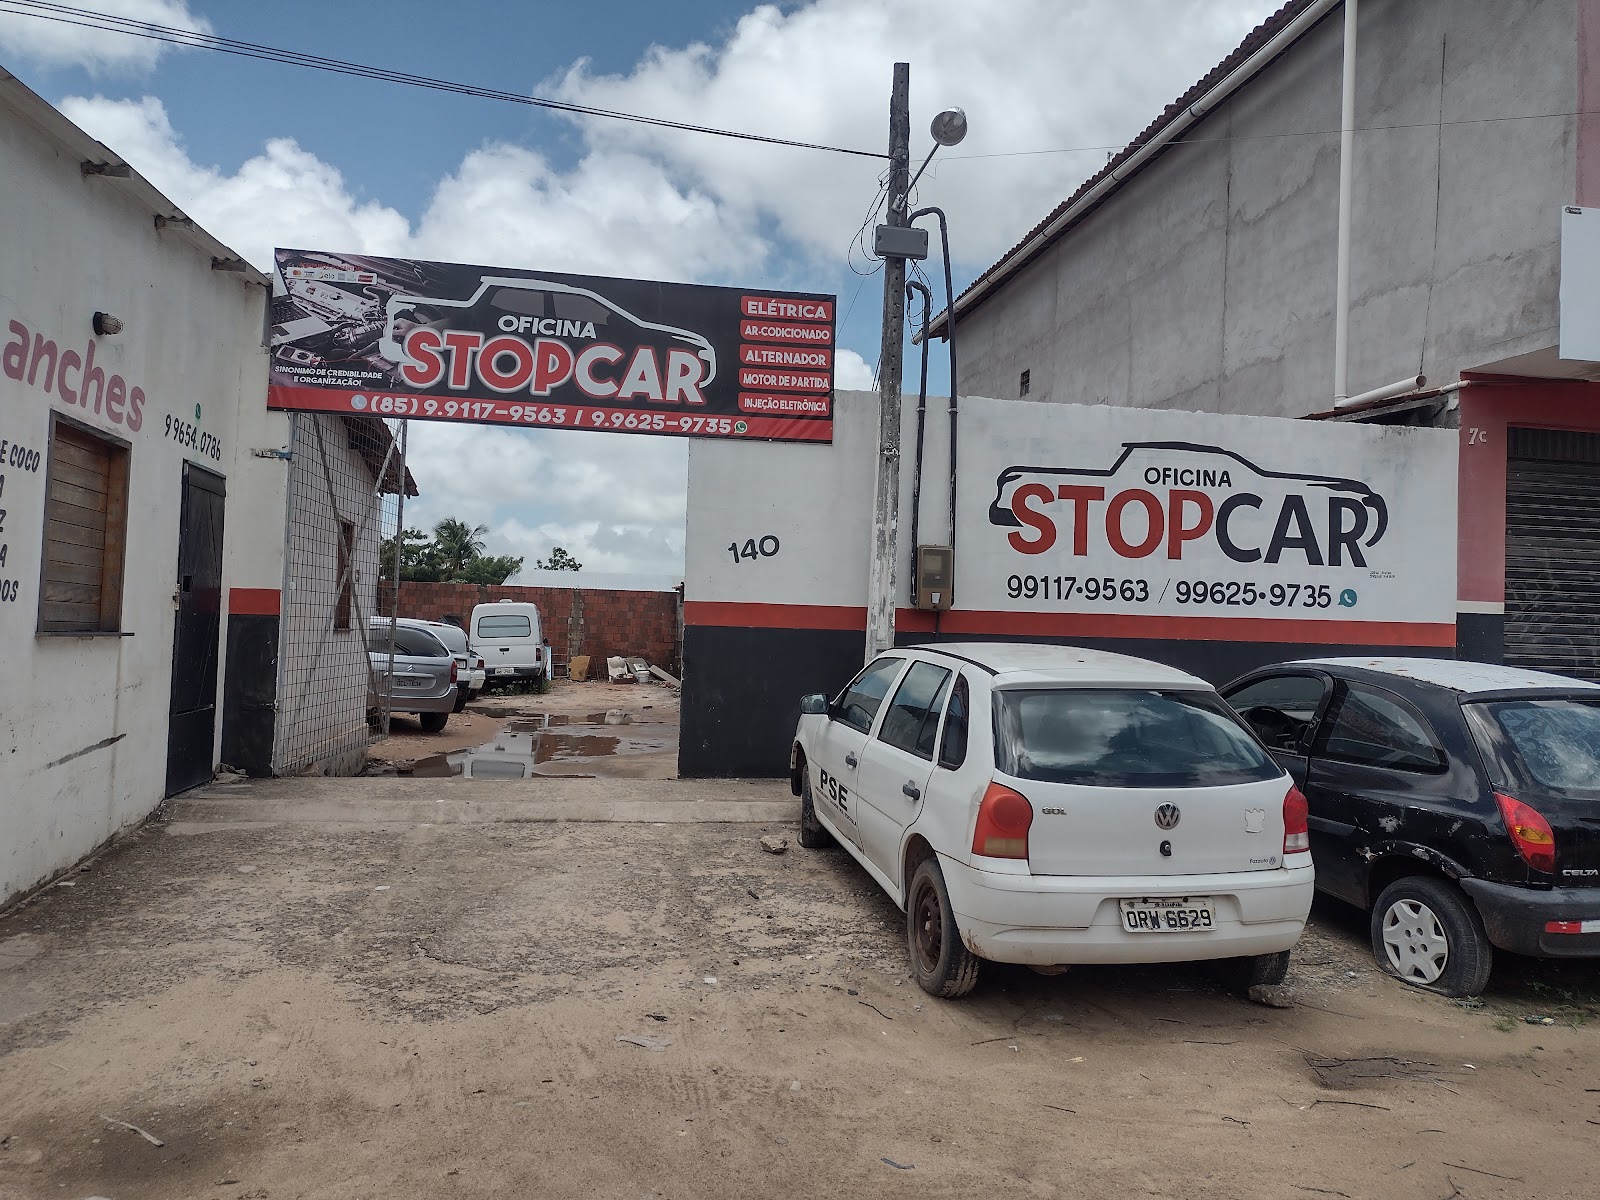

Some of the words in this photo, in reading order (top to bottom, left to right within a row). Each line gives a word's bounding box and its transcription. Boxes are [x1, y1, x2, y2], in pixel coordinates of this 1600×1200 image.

[747, 300, 827, 319] ELÉTRICA
[497, 315, 597, 339] OFICINA
[744, 325, 830, 340] AR-CODICIONADO
[402, 329, 705, 405] STOPCAR
[745, 350, 826, 366] ALTERNADOR
[274, 365, 316, 375] SINONIMO
[316, 368, 326, 376] DE
[326, 369, 383, 379] CREDIBILIDADE
[293, 375, 299, 383] E
[299, 376, 362, 387] ORGANIZAÇÃO!
[743, 373, 777, 386] MOTOR
[778, 375, 790, 387] DE
[791, 377, 829, 389] PARTIDA
[370, 395, 417, 414] (85)
[423, 399, 566, 424] 9.9117-9563
[591, 411, 732, 434] 9.9625-9735
[744, 397, 780, 410] INJEÇÃO
[780, 399, 827, 412] ELETRÔNICA
[165, 413, 172, 437] 9
[173, 417, 221, 461] 9654.0786
[9, 444, 41, 473] COCO
[1144, 467, 1232, 488] OFICINA
[1007, 482, 1368, 568] STOPCAR
[727, 534, 780, 564] 140
[820, 767, 848, 812] PSE
[1042, 806, 1067, 815] GOL
[1562, 869, 1599, 877] CELTA
